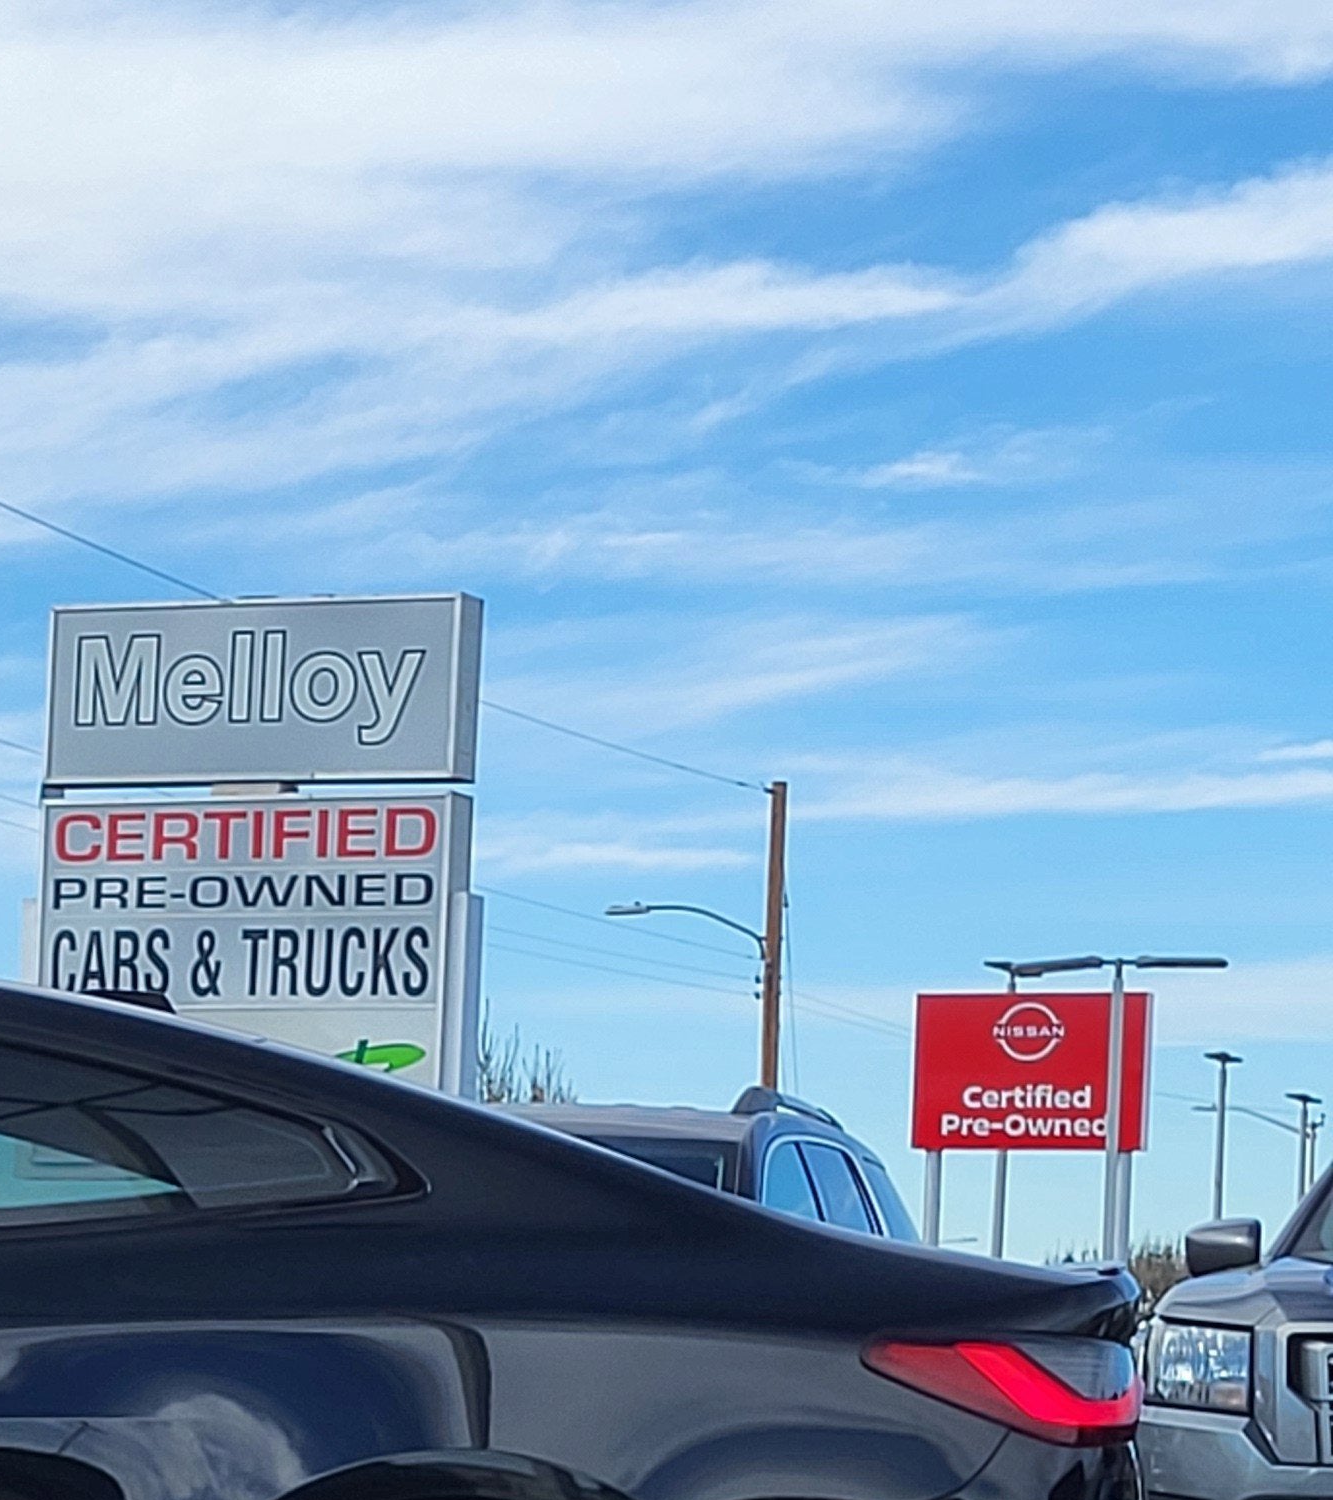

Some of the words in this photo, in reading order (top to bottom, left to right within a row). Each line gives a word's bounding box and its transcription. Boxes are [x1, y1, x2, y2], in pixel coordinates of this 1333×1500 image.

[74, 629, 427, 746] Melloy
[54, 806, 438, 863] CERTIFIED
[52, 873, 433, 910] PRE-OWNED
[51, 928, 171, 995] CARS
[190, 928, 222, 998] &
[241, 924, 429, 998] TRUCKS
[992, 1025, 1065, 1038] NISSAN
[962, 1085, 1092, 1109] Certified
